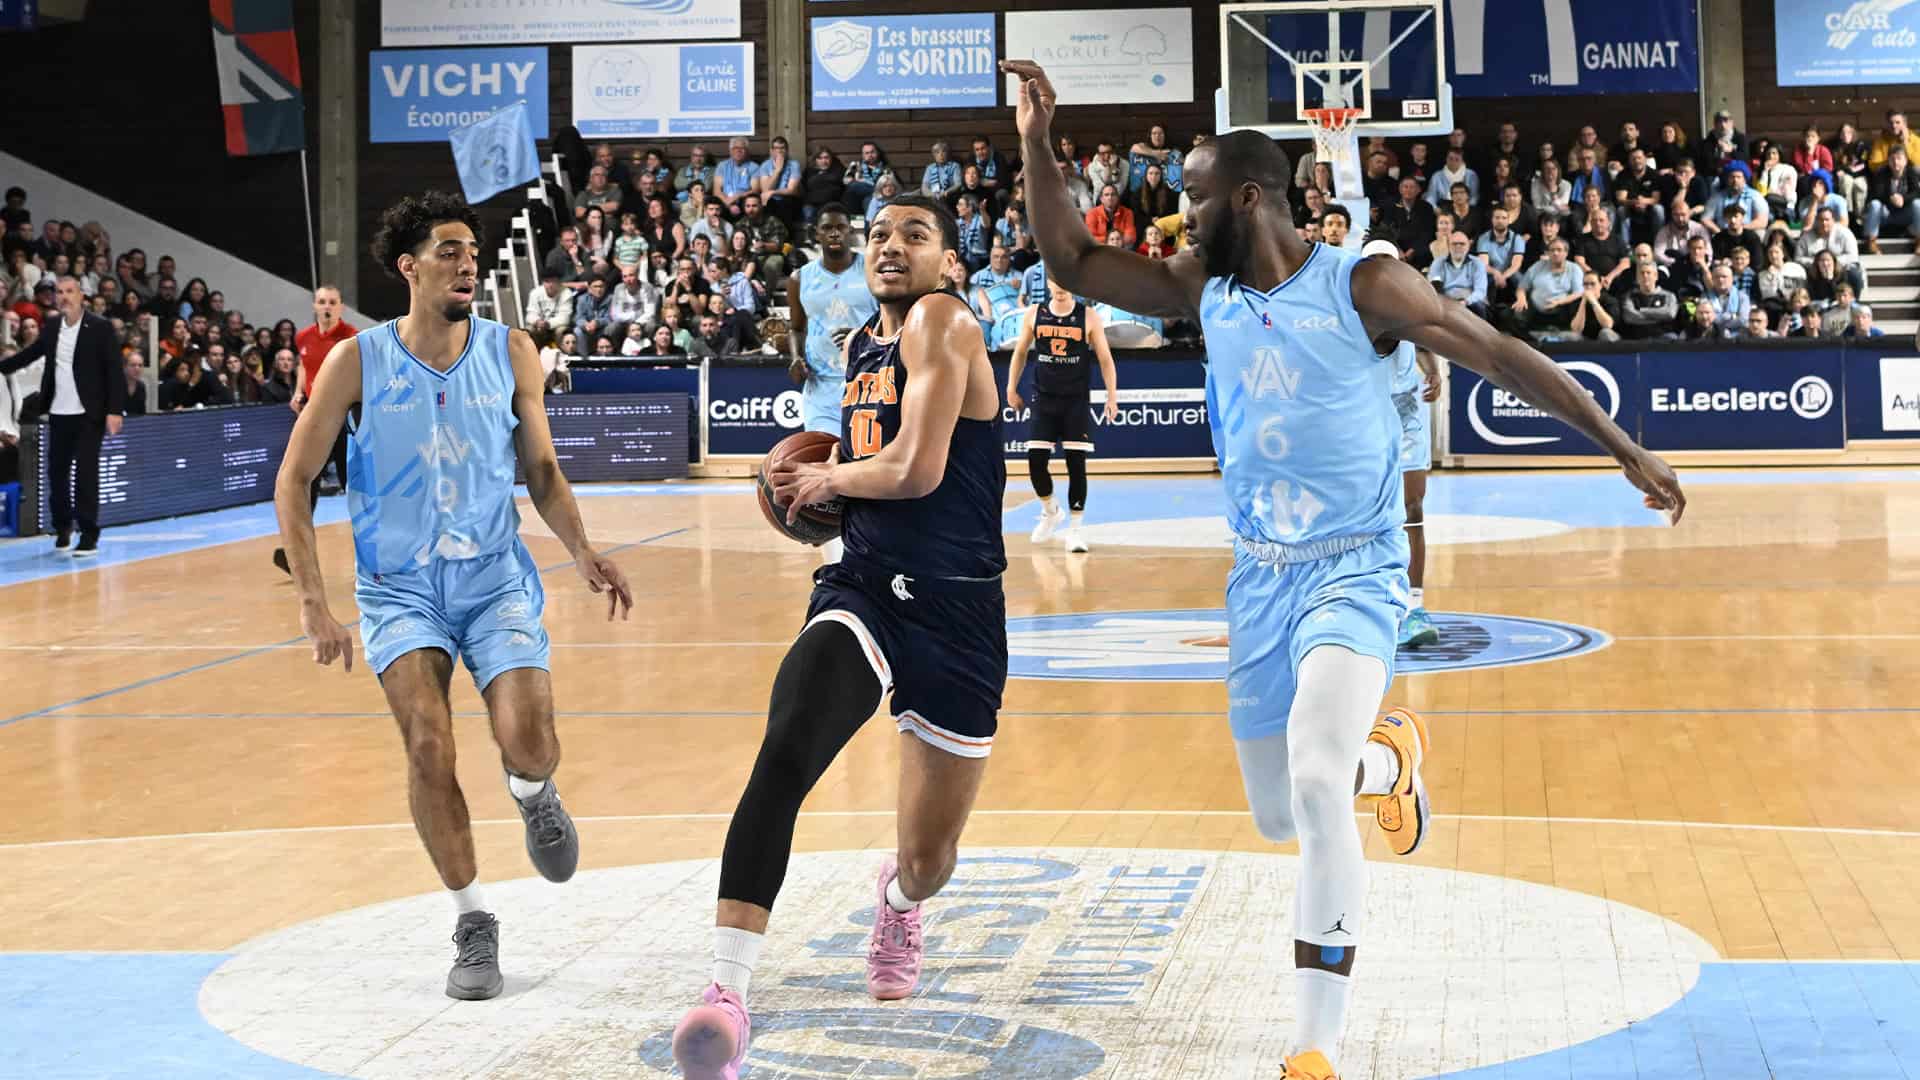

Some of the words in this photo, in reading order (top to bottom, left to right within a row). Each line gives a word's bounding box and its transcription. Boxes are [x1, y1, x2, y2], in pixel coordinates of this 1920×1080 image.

[878, 25, 906, 47] Les
[911, 26, 991, 46] brasseurs
[899, 47, 992, 76] SORNIN
[1583, 41, 1679, 69] GANNAT
[382, 62, 536, 97] VICHY
[1530, 74, 1549, 84] TM
[1651, 388, 1788, 411] E.Leclerc
[849, 409, 883, 459] 10
[1256, 415, 1290, 460] 6
